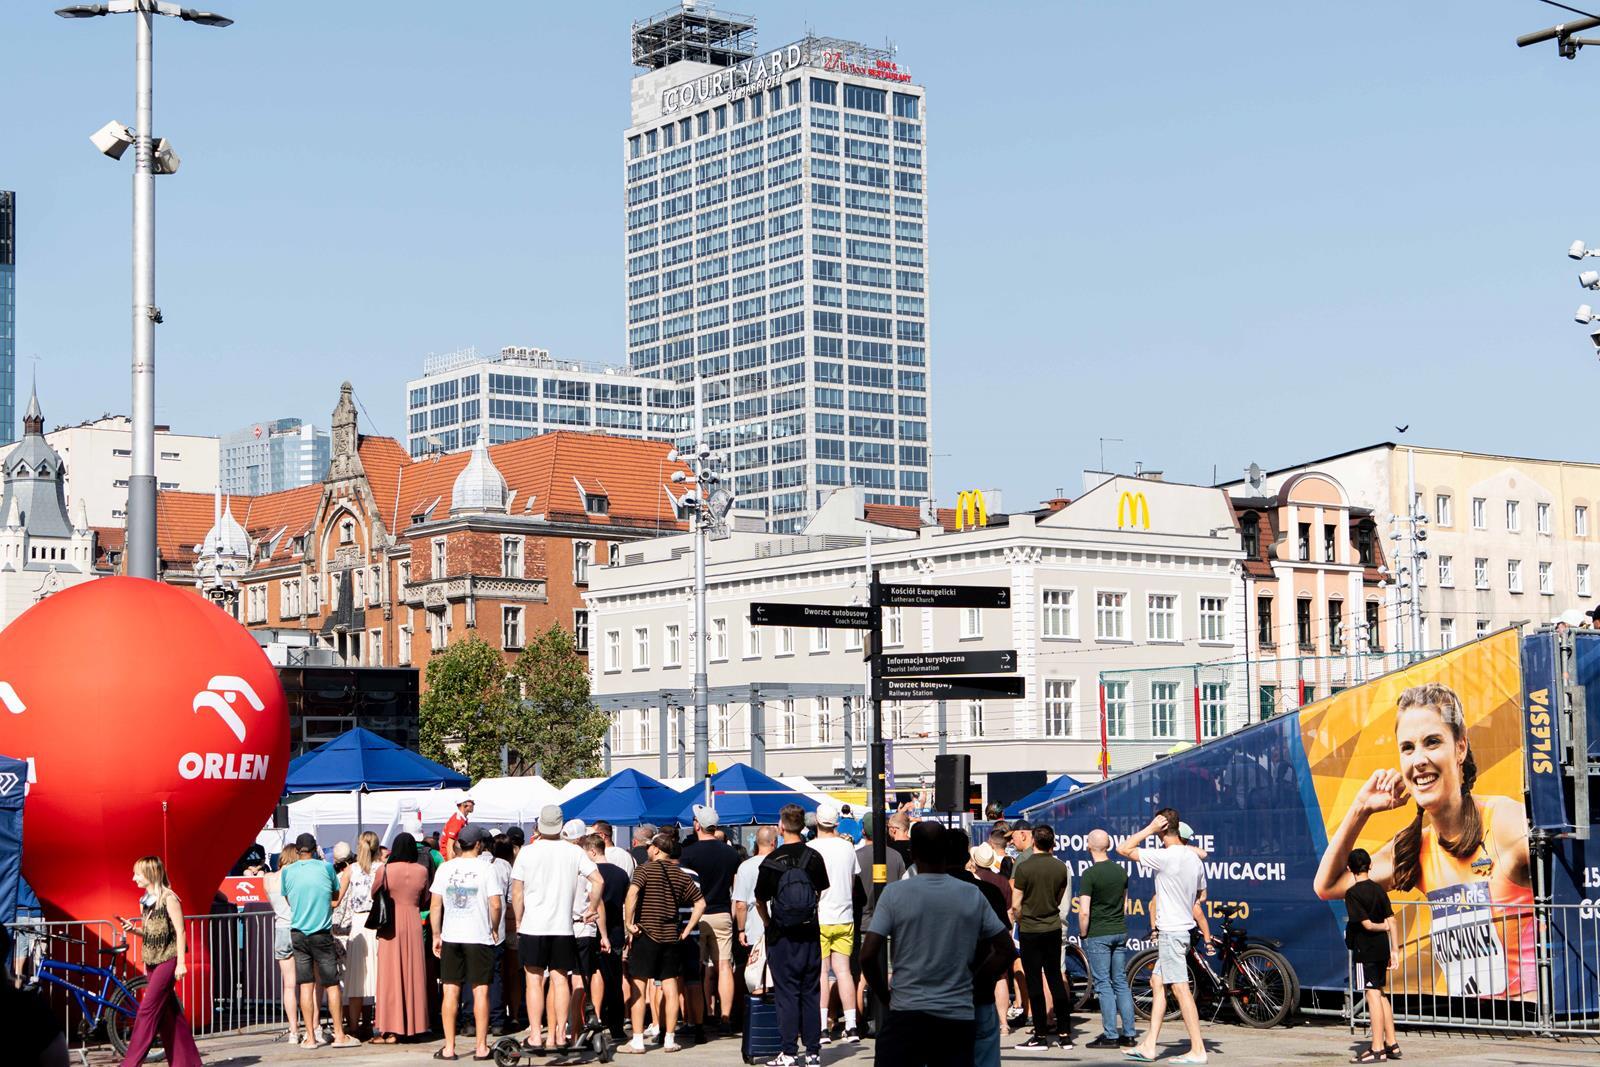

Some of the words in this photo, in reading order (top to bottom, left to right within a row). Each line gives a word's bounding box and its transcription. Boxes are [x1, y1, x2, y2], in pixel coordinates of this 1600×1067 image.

[664, 44, 802, 112] COURTYARD
[727, 90, 738, 100] BY
[740, 72, 784, 98] MARRIOTT
[891, 587, 916, 595] Kościół
[917, 588, 956, 597] Ewangelicki
[804, 608, 831, 616] Dworzec
[832, 610, 869, 618] autobusowy
[887, 657, 924, 665] Informacja
[925, 655, 966, 664] turystyczna
[888, 689, 911, 697] Railway
[1530, 688, 1553, 775] SILESIA
[178, 752, 270, 781] ORLEN
[1204, 862, 1286, 881] WICACH!
